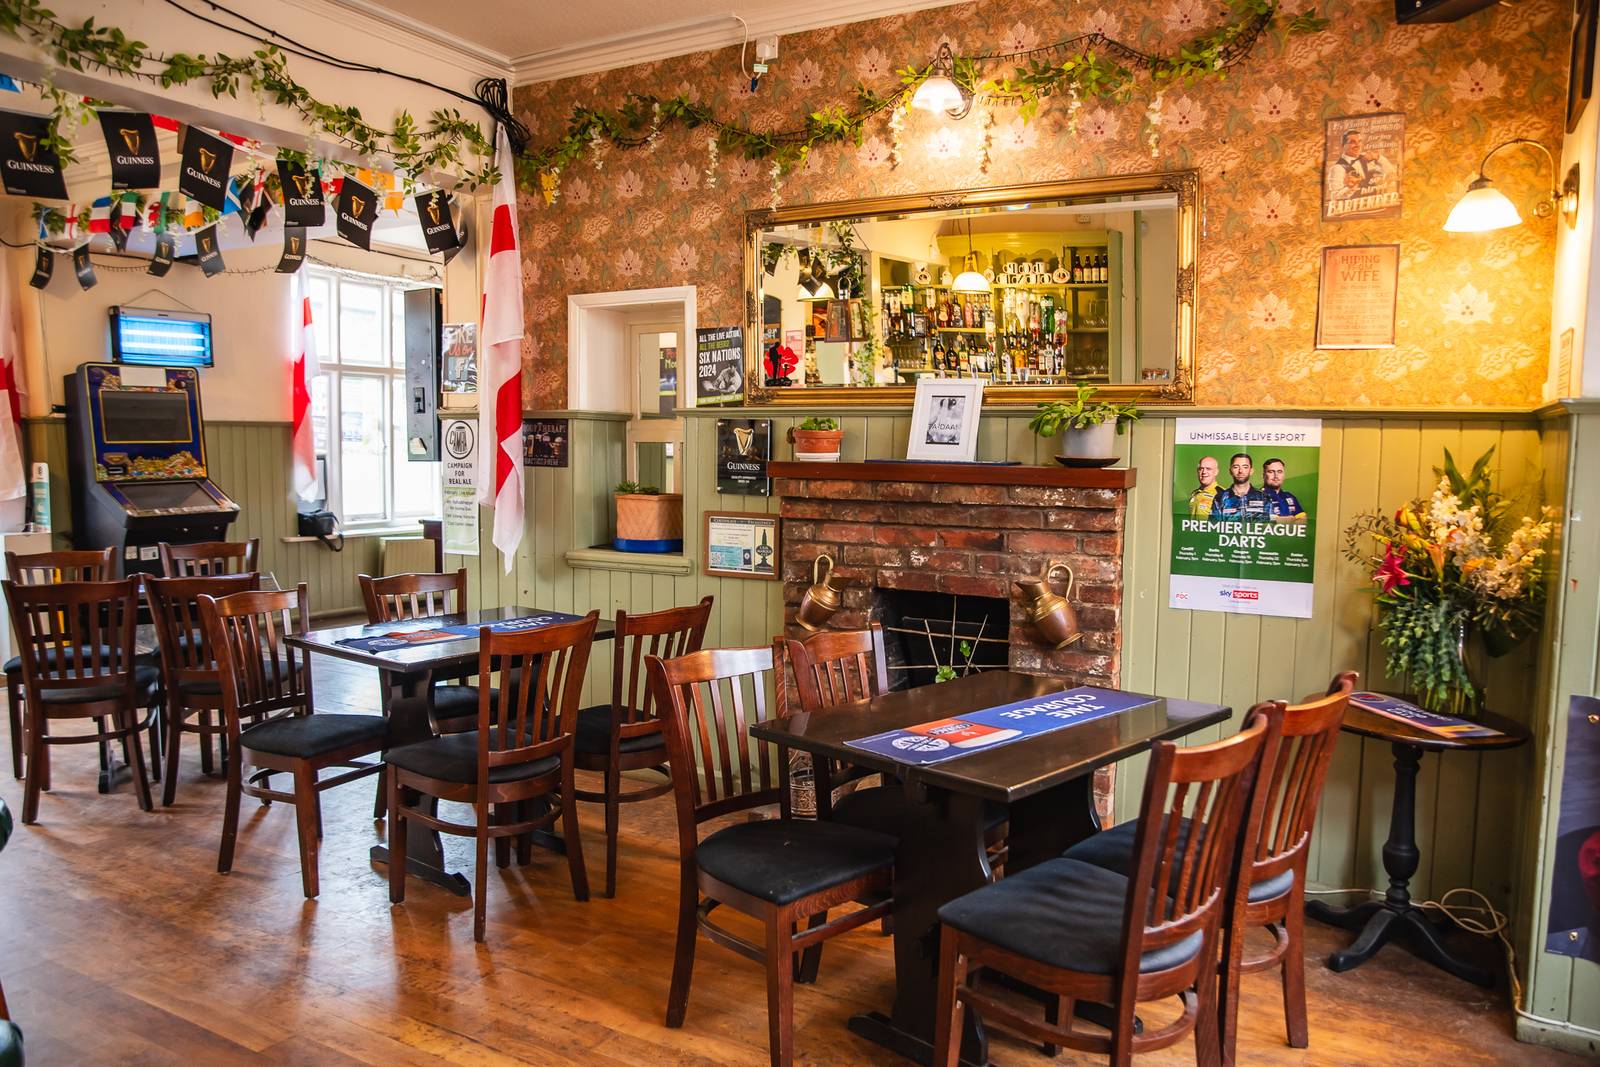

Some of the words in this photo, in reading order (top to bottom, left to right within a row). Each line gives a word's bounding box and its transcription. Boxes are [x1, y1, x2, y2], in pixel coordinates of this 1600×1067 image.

[7, 159, 55, 174] GUINNESS
[116, 155, 154, 165] GUINNESS
[187, 167, 221, 188] GUINNESS
[289, 197, 320, 206] GUINNESS
[1327, 192, 1399, 217] BARTENDER
[341, 211, 368, 231] GUINNESS
[427, 223, 450, 235] GUINNESS
[1341, 255, 1380, 264] HIDING
[1341, 270, 1380, 281] WIFE
[699, 334, 707, 342] ALL
[707, 333, 716, 341] THE
[716, 331, 725, 340] LIVE
[699, 351, 710, 364] SIX
[712, 347, 741, 362] NATIONS
[699, 364, 716, 378] 2024
[1189, 432, 1249, 441] UNMISSABLE
[1251, 432, 1272, 441] LIVE
[1274, 433, 1306, 442] SPORT
[727, 461, 760, 471] GUINNESS
[1181, 519, 1242, 534] PREMIER
[1246, 523, 1307, 537] LEAGUE
[1218, 535, 1266, 549] DARTS
[1220, 589, 1232, 598] sky
[1234, 591, 1258, 599] sports
[999, 694, 1097, 719] COURAGE
[1046, 703, 1105, 719] TAKE
